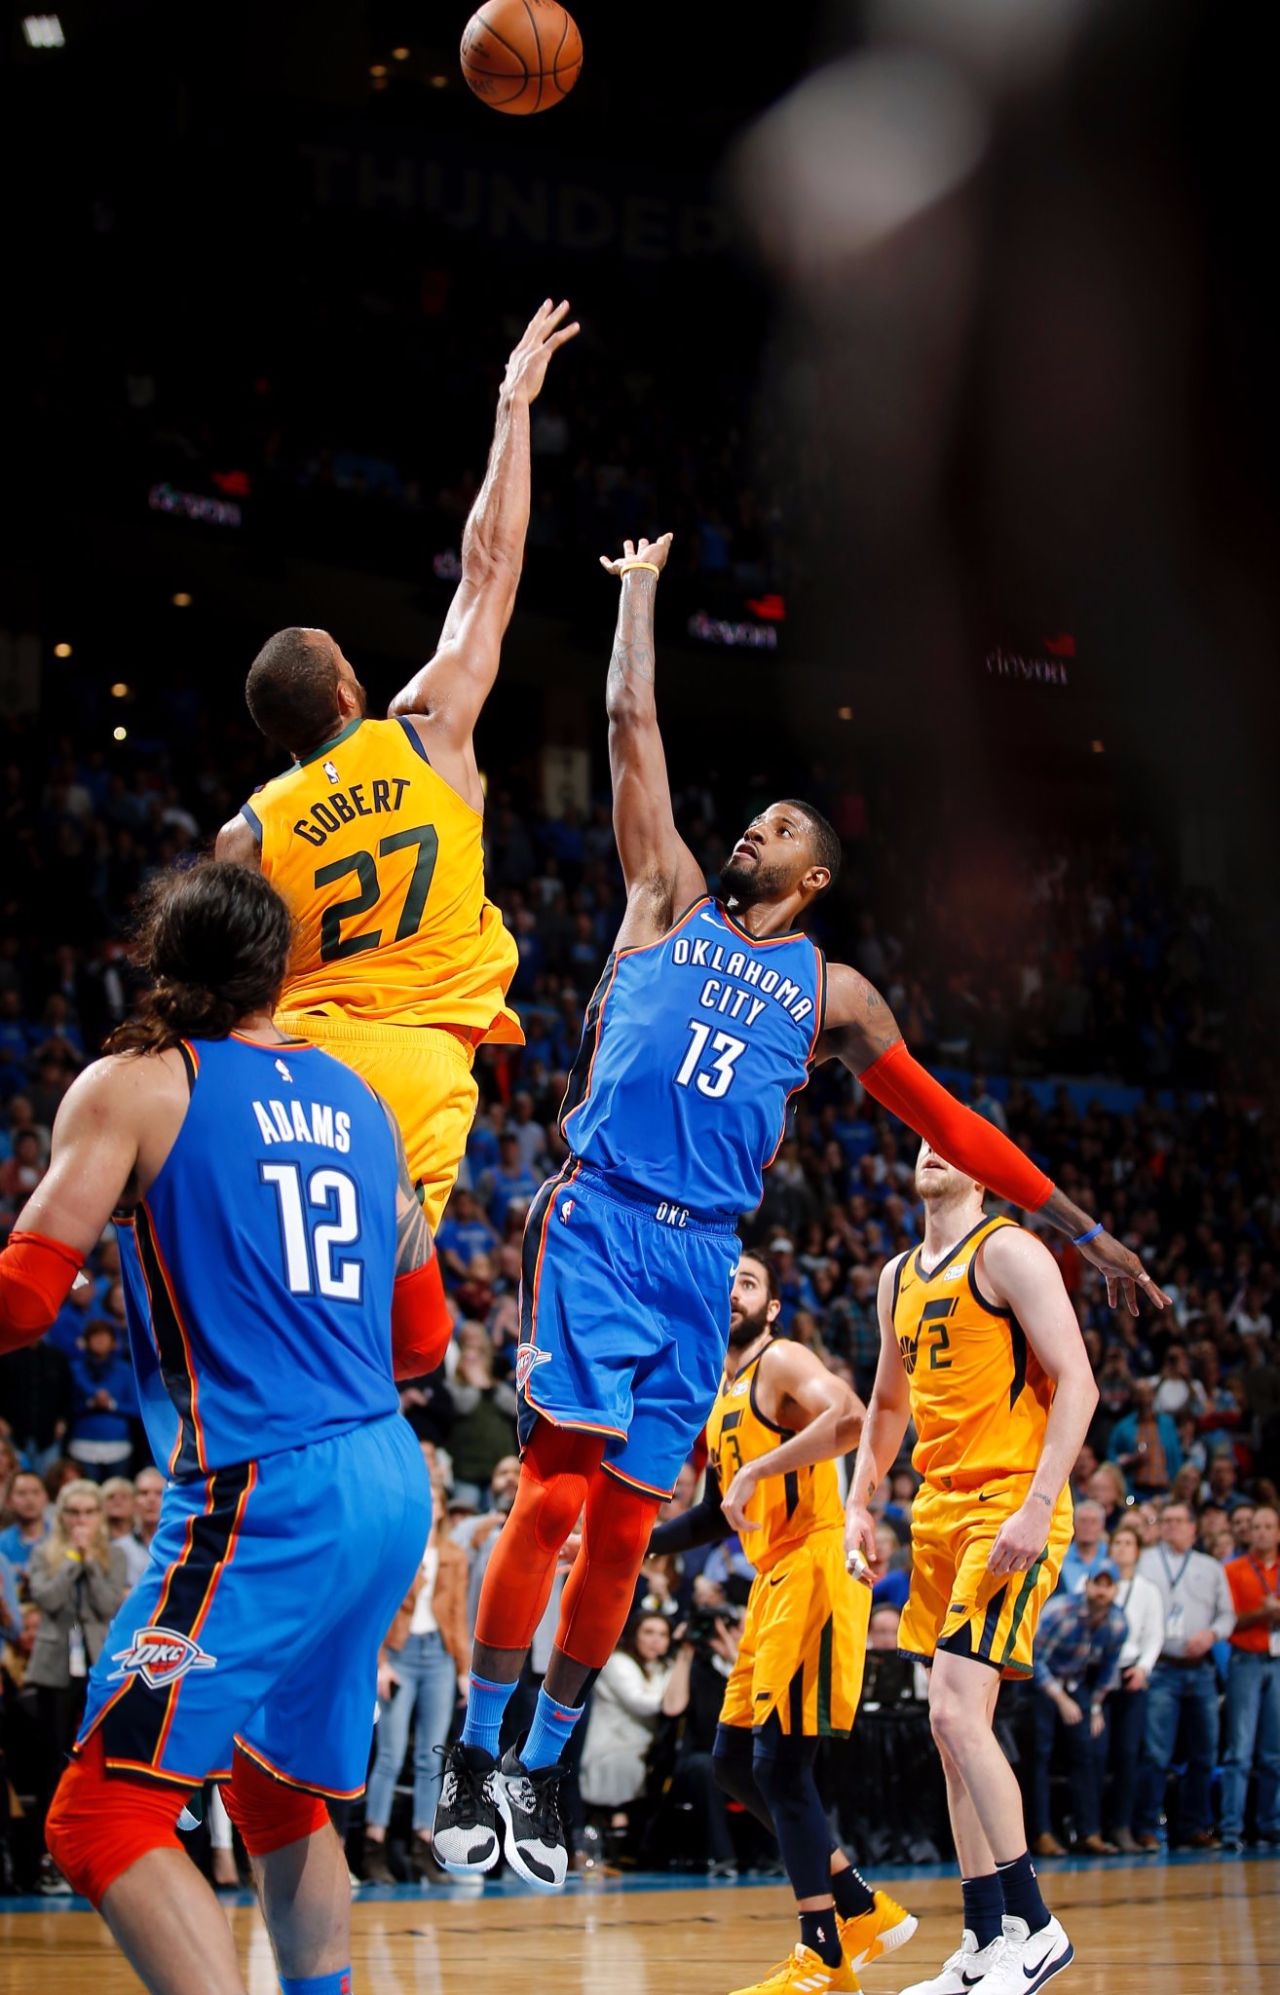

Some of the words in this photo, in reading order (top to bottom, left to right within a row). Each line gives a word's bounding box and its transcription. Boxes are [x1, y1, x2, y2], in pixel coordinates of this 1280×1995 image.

[293, 778, 410, 847] GOBERT
[314, 824, 439, 963] 27
[671, 938, 814, 1025] OKLAHOMA
[699, 979, 769, 1026] CITY
[673, 1018, 749, 1099] 13
[252, 1100, 351, 1154] ADAMS
[257, 1160, 364, 1306] 12
[655, 1201, 690, 1228] OKC
[927, 1323, 952, 1370] 2
[726, 1434, 744, 1476] 3
[124, 1643, 184, 1668] OKC
